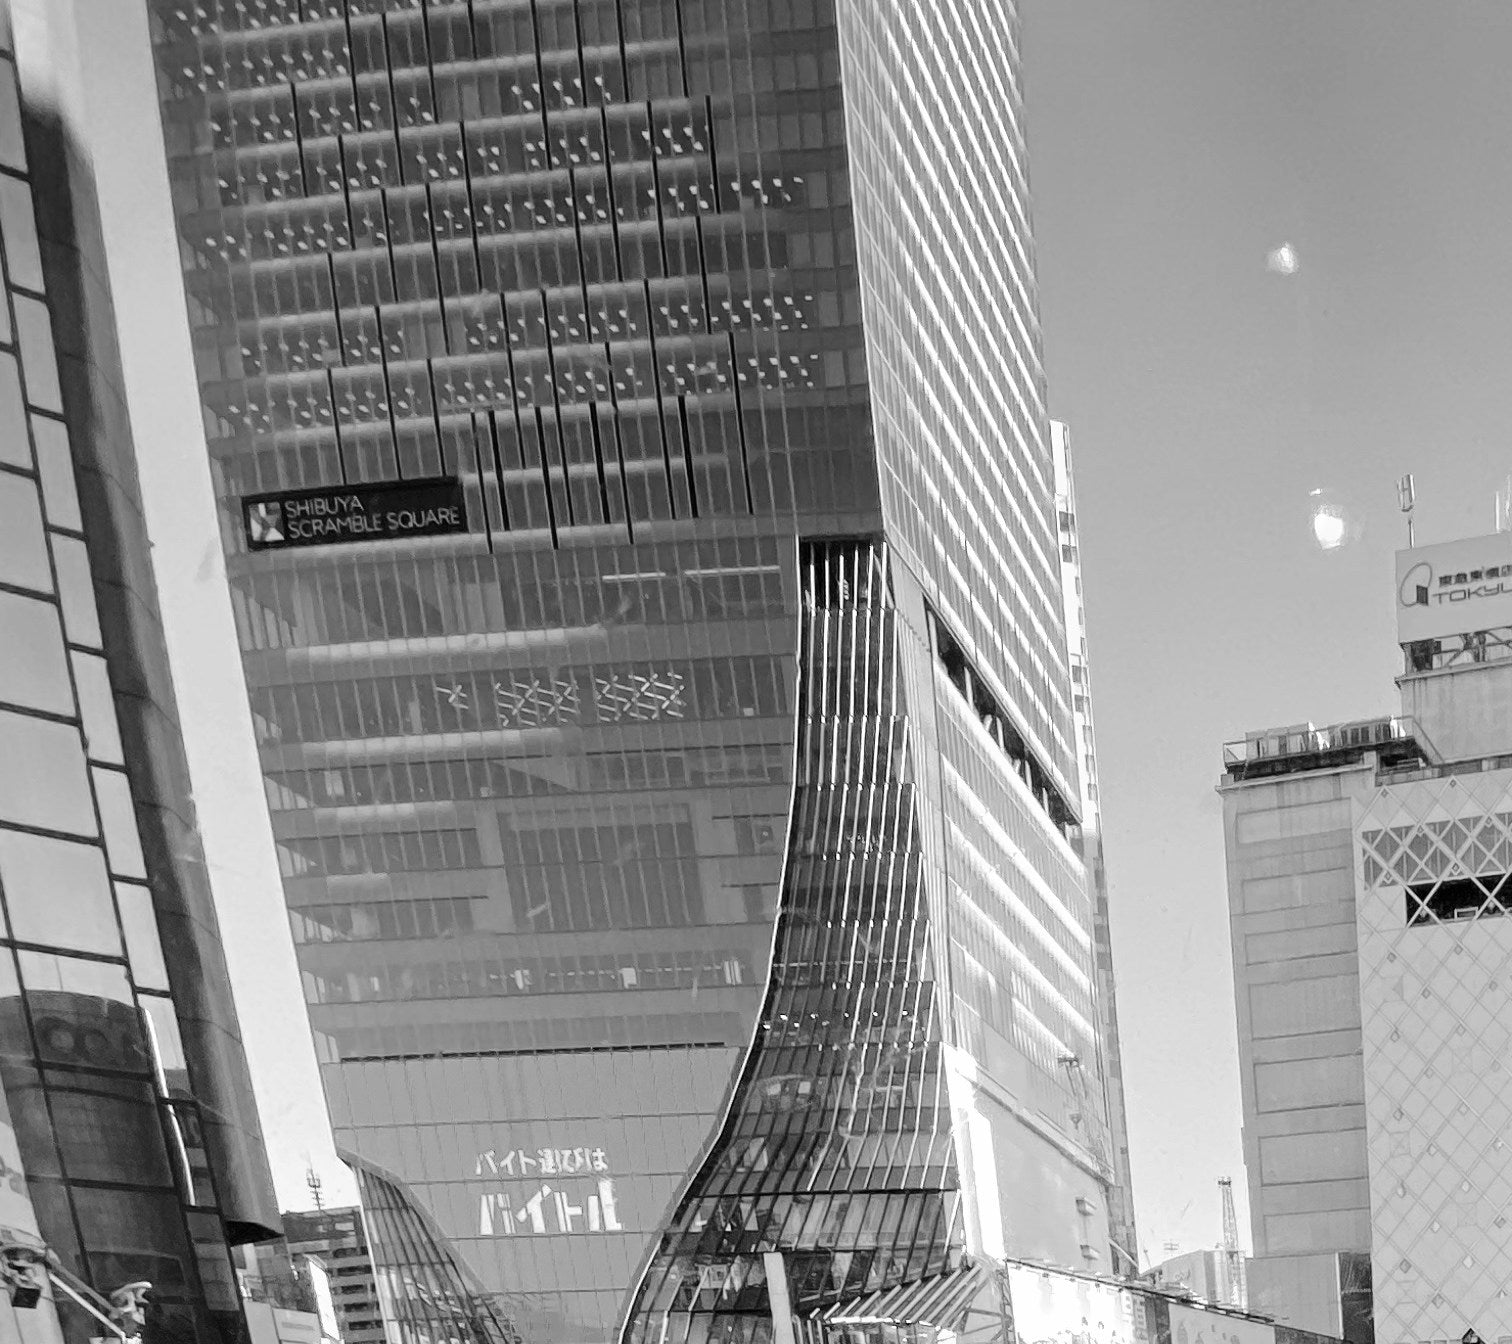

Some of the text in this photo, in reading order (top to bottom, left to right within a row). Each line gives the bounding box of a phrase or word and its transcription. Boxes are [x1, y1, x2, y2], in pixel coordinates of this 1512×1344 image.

[285, 496, 364, 518] SHIBUYA
[288, 507, 460, 538] SCRAMBLE SQUARE
[475, 1147, 609, 1176] バイト選びは
